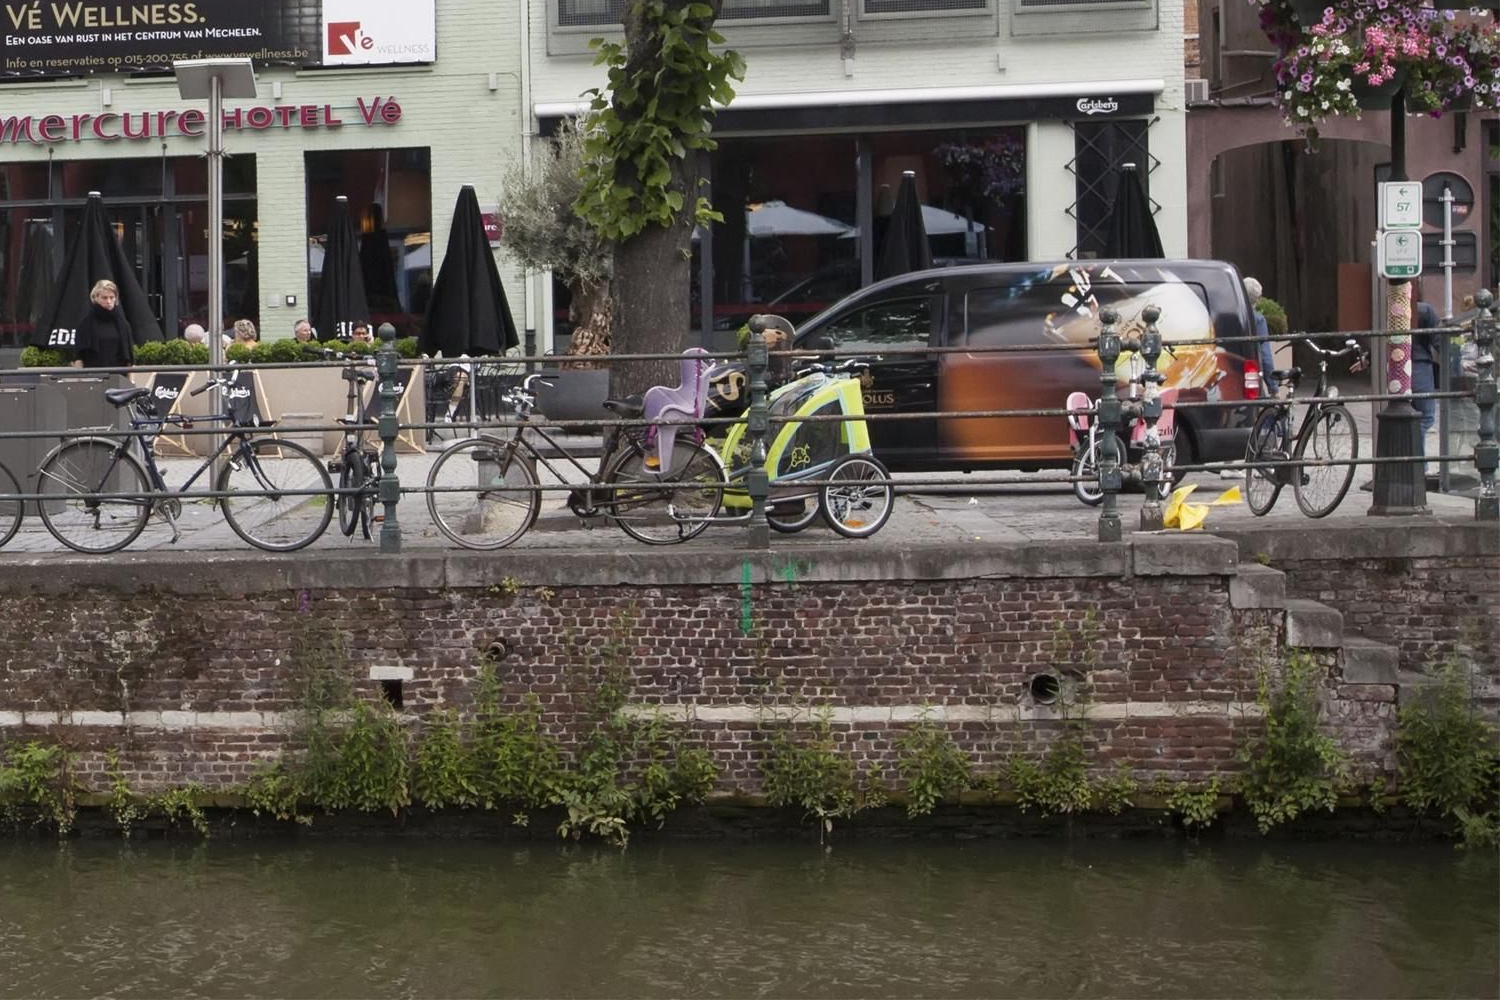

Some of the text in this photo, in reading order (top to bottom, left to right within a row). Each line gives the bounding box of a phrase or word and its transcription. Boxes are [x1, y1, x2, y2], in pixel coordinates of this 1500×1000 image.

[27, 36, 53, 45] OASE
[54, 34, 74, 43] VAN
[76, 33, 100, 43] RUST
[101, 33, 112, 42] IN
[114, 32, 133, 41] HET
[135, 31, 181, 41] CENTRUM
[183, 30, 203, 38] VAN
[377, 44, 430, 55] WELLNESS
[6, 57, 27, 69] Info
[29, 59, 44, 68] en
[46, 55, 105, 67] reservaties
[107, 57, 122, 67] op
[1076, 96, 1119, 114] Carlsberg
[221, 104, 343, 130] HOTEL
[357, 96, 403, 126] Vé
[1396, 202, 1411, 212] 57
